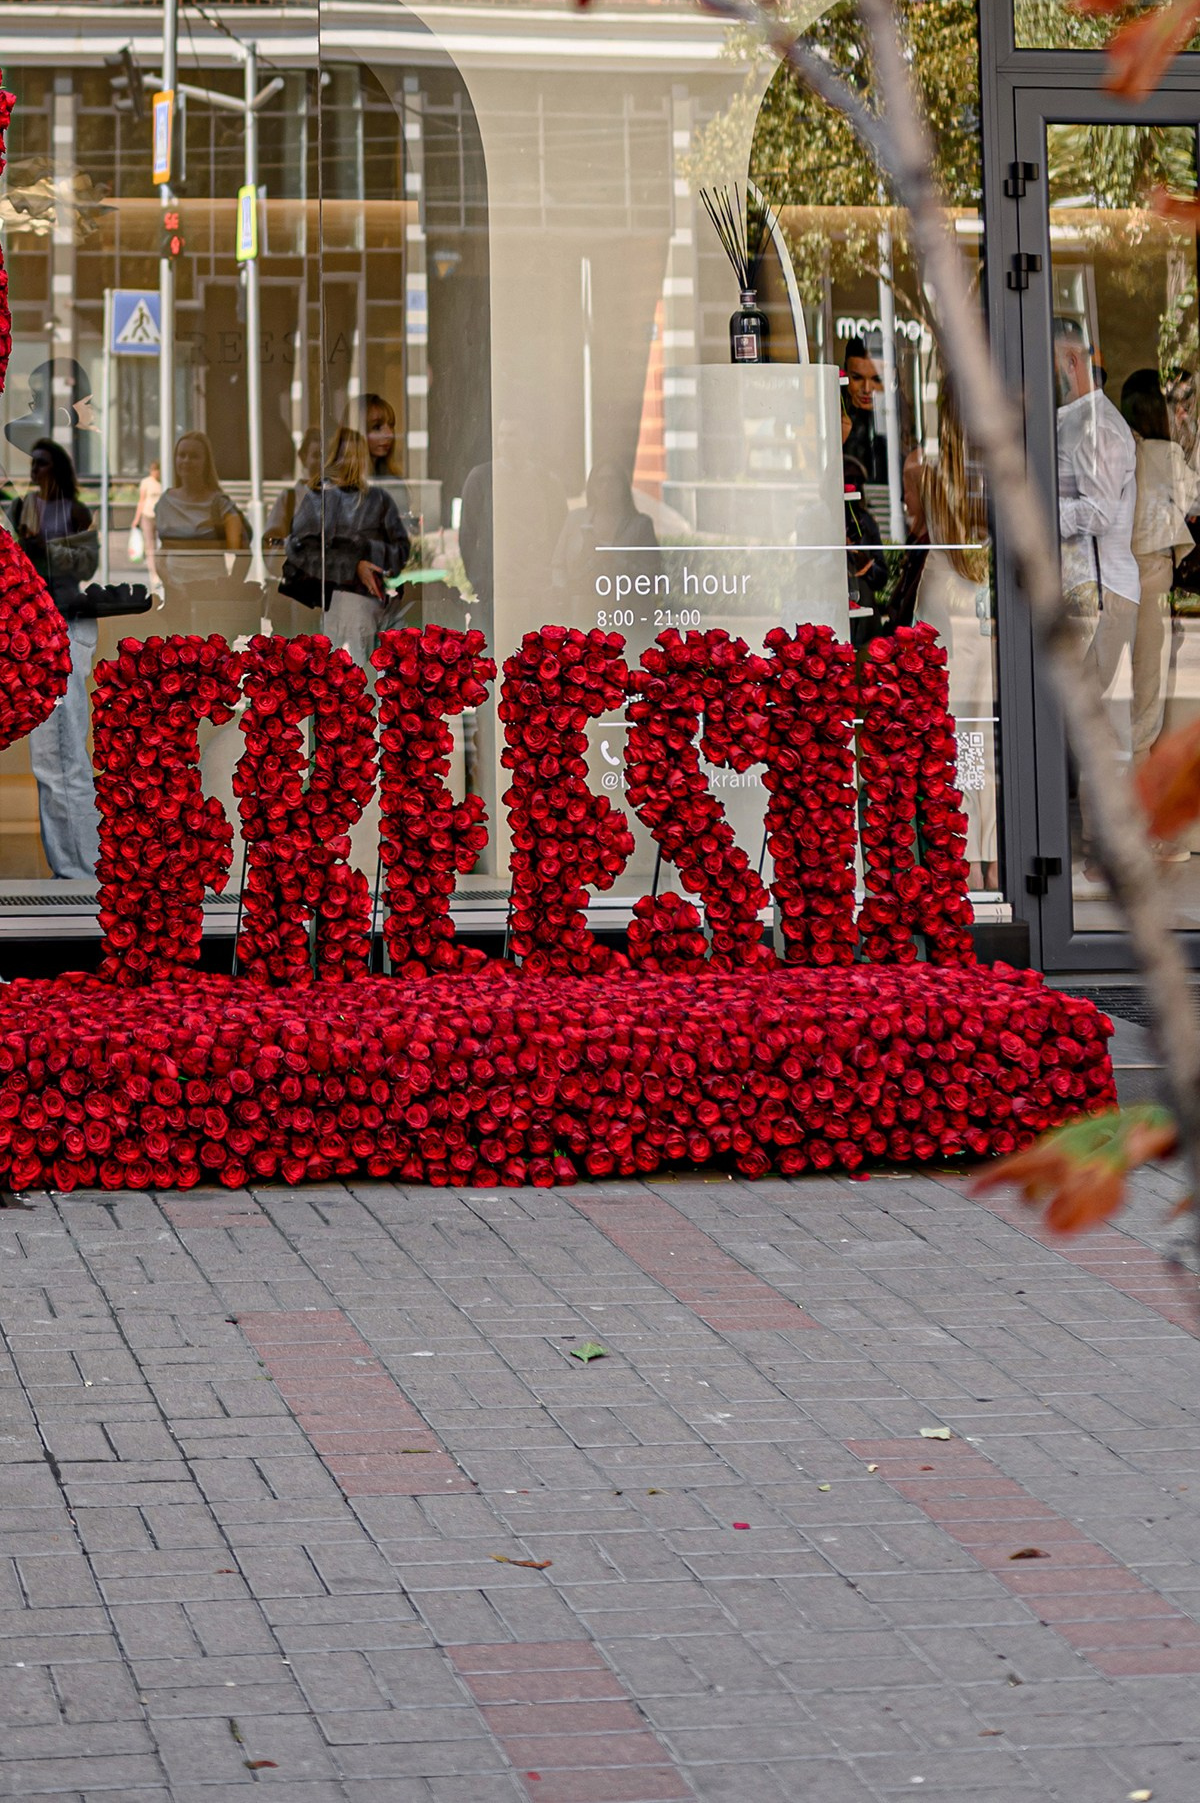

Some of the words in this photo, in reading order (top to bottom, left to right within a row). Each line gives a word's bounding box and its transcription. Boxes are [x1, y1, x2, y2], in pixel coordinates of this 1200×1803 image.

[595, 573, 671, 601] open
[683, 566, 752, 596] hour
[597, 609, 635, 627] 8:00
[654, 608, 701, 627] 21:00
